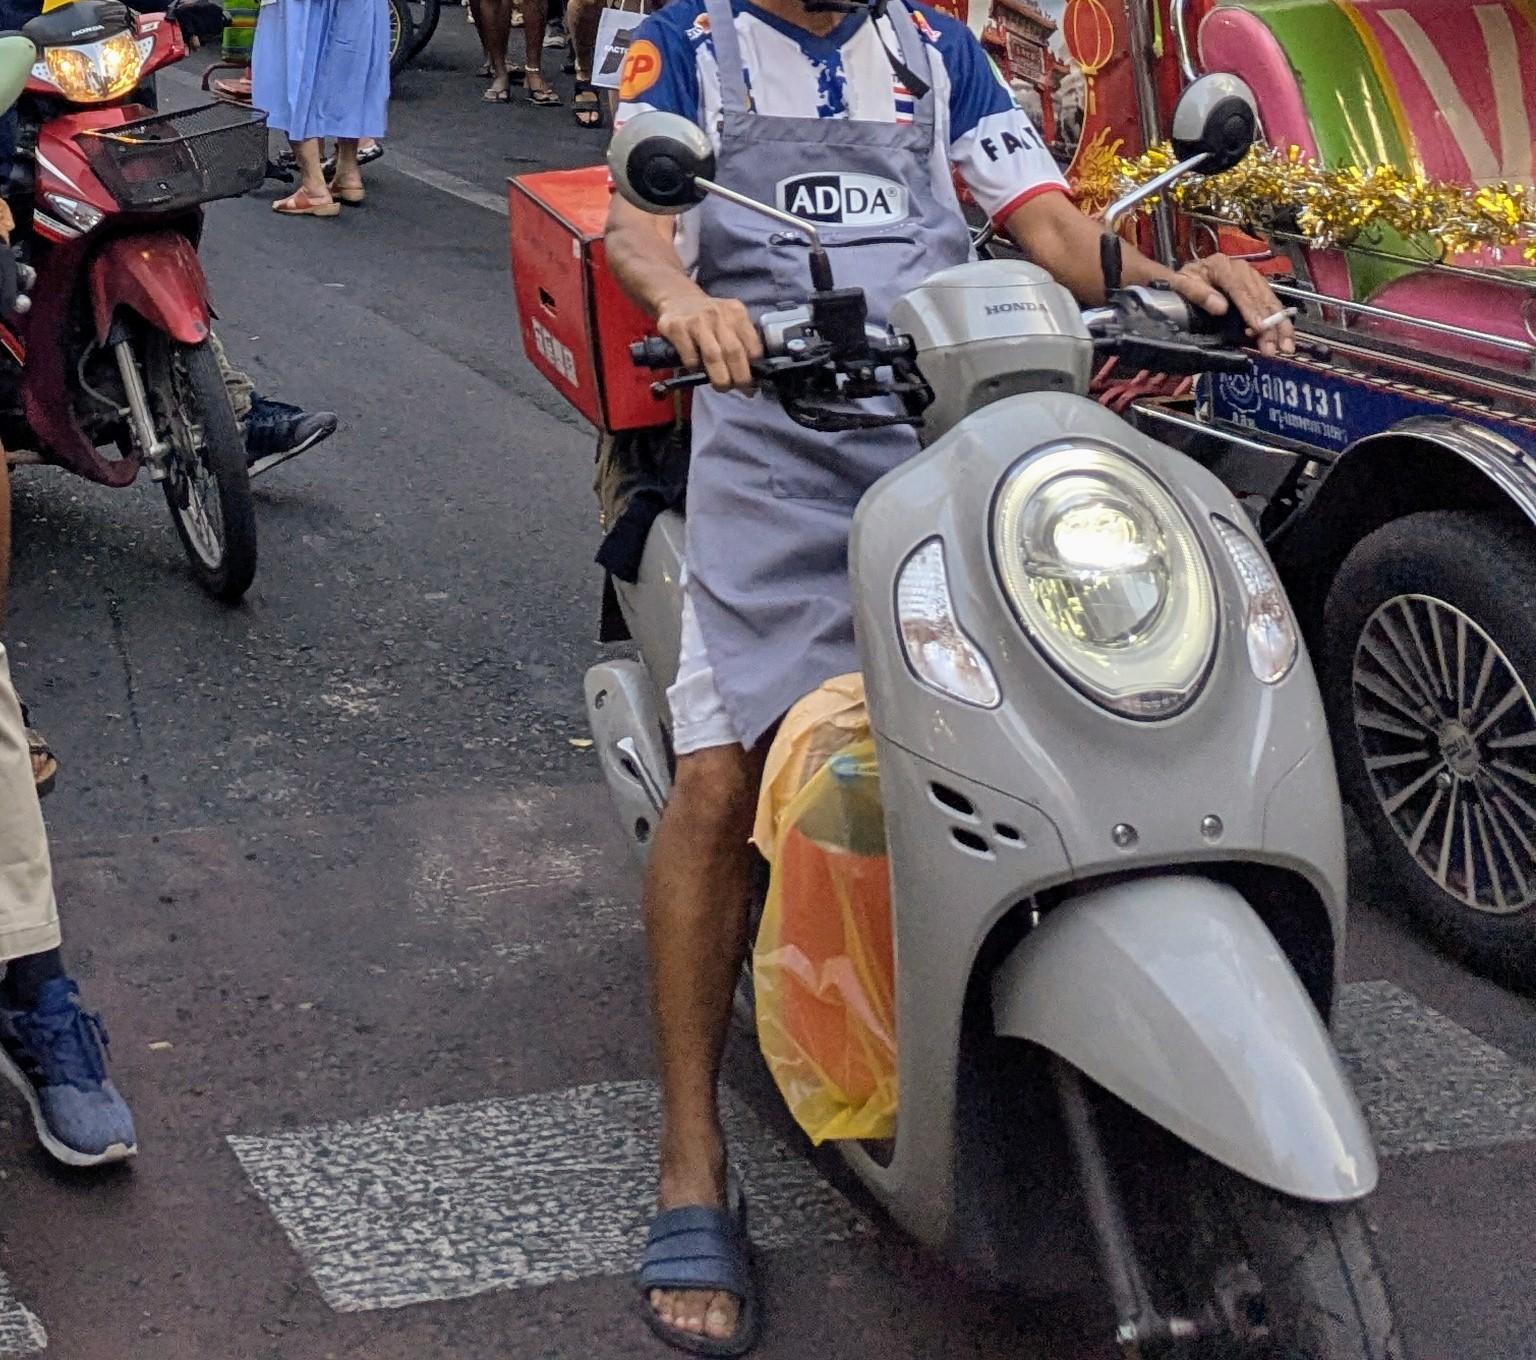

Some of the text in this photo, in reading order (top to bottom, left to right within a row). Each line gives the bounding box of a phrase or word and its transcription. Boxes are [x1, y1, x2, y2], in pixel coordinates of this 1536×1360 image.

[71, 24, 105, 37] HONDA
[790, 185, 893, 215] ADDA
[985, 301, 1048, 317] HONDA
